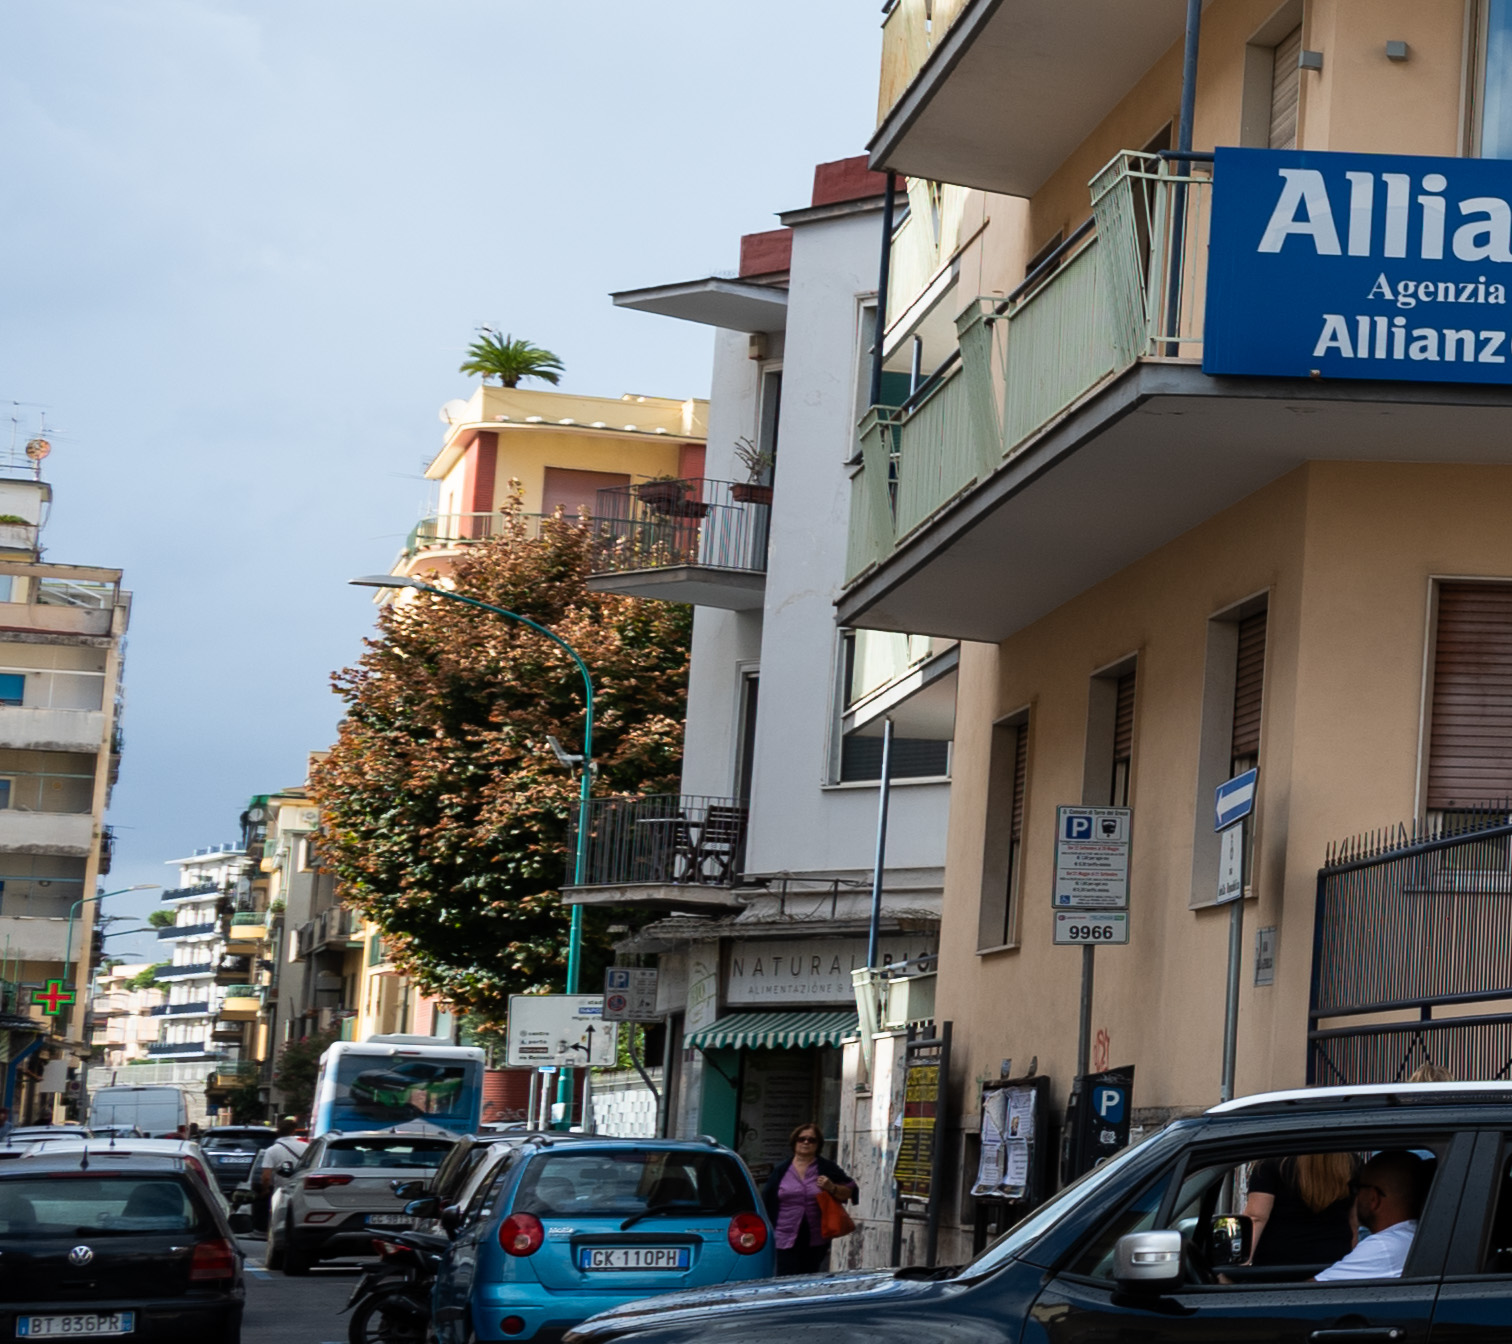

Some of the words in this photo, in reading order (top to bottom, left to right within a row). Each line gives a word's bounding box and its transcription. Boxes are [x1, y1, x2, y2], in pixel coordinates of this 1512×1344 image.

[1366, 271, 1507, 310] Agenzia
[1311, 314, 1506, 364] Allianz
[1072, 818, 1089, 838] P
[1069, 925, 1113, 940] 9966
[1101, 1090, 1120, 1117] P
[593, 1251, 614, 1267] GK
[623, 1250, 677, 1266] 110PH
[31, 1318, 55, 1334] BT
[62, 1316, 120, 1332] 836PR
